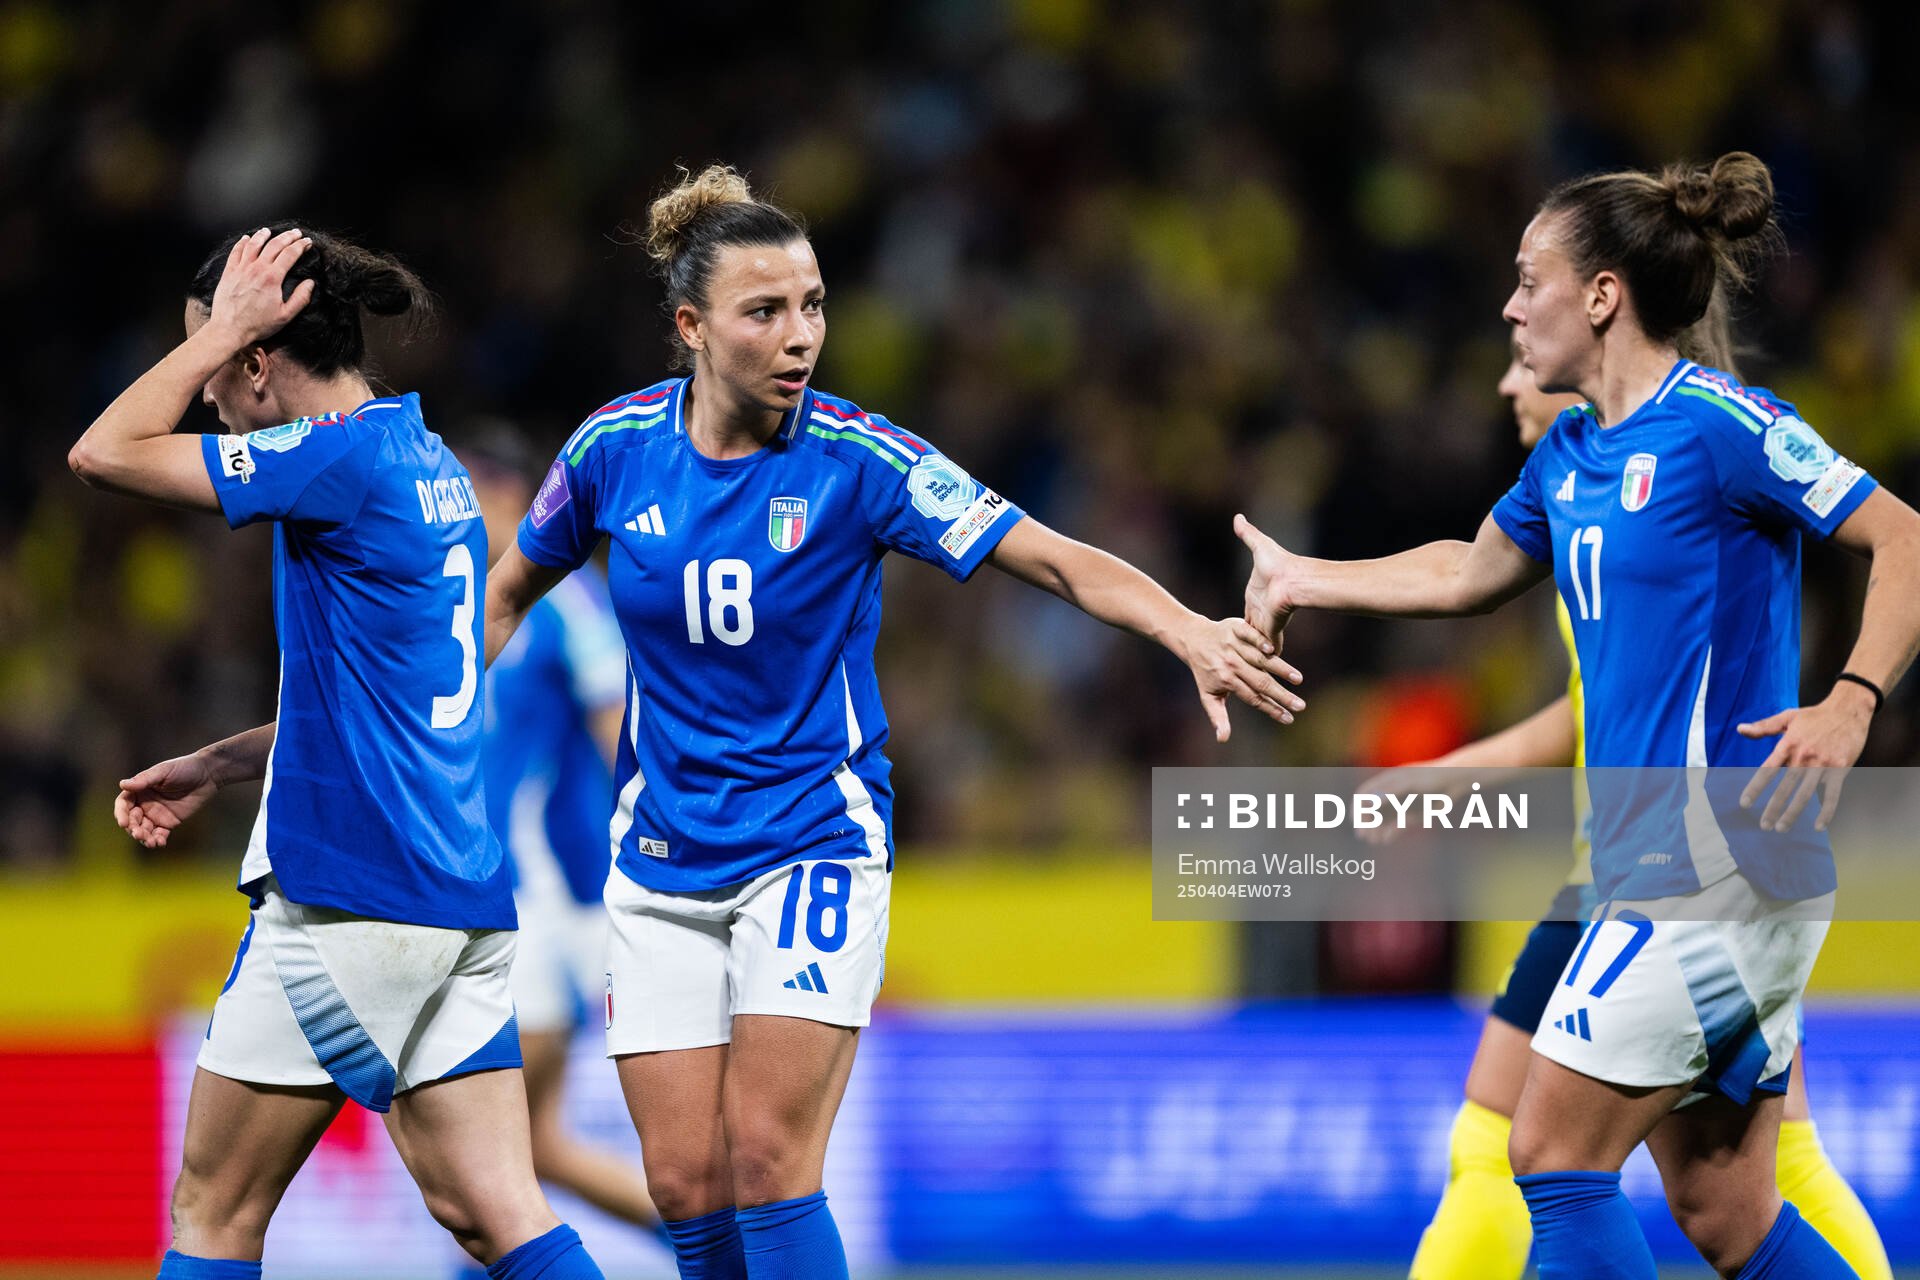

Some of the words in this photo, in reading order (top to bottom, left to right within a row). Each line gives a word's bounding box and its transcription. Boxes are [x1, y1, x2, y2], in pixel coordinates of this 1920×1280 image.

[415, 480, 437, 524] DI
[773, 501, 804, 513] ITALIA
[938, 481, 960, 502] Strong
[683, 559, 754, 646] 18
[1569, 525, 1603, 620] 17
[431, 544, 477, 729] 3
[777, 861, 852, 953] 18
[1565, 901, 1654, 998] 17
